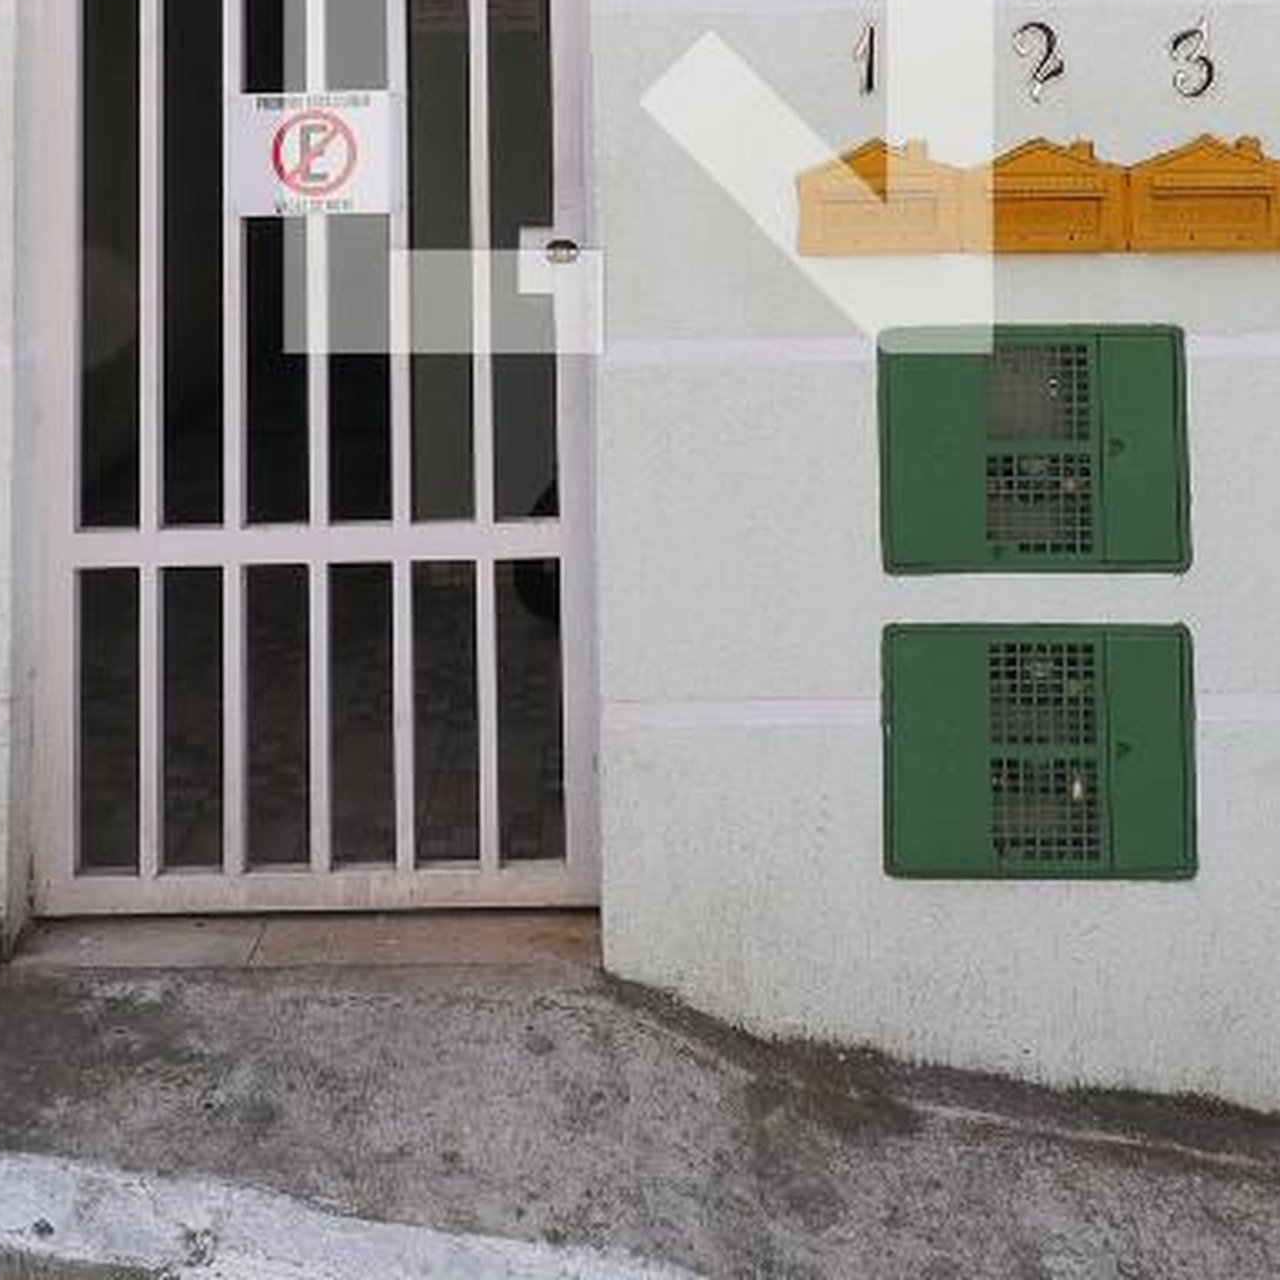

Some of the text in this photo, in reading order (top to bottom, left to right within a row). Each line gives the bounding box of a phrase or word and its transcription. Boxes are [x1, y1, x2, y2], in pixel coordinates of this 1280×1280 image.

[855, 22, 875, 94] 1
[1012, 22, 1065, 103] 2
[1170, 17, 1214, 98] 3
